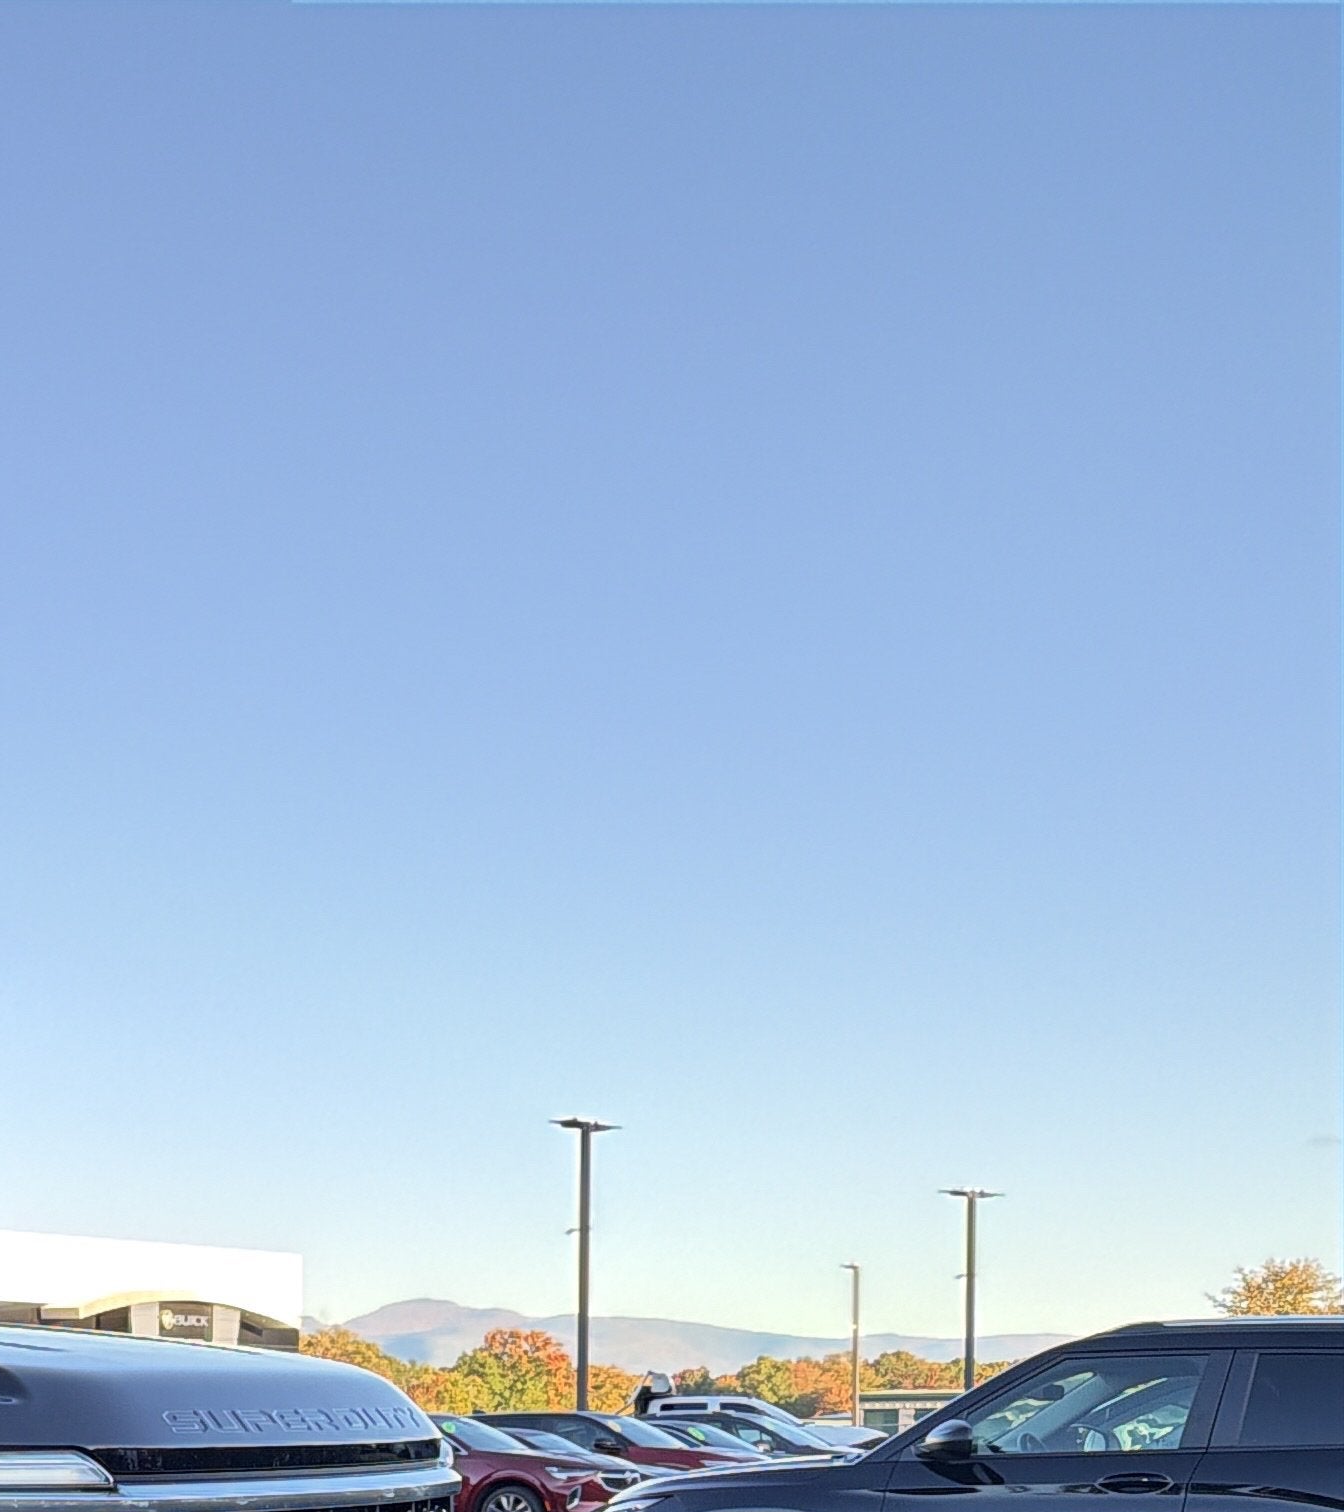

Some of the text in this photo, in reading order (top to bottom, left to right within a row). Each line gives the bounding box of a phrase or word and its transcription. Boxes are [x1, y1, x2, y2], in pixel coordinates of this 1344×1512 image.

[173, 1313, 209, 1328] BUICK
[162, 1406, 422, 1434] SUPER DUTY
